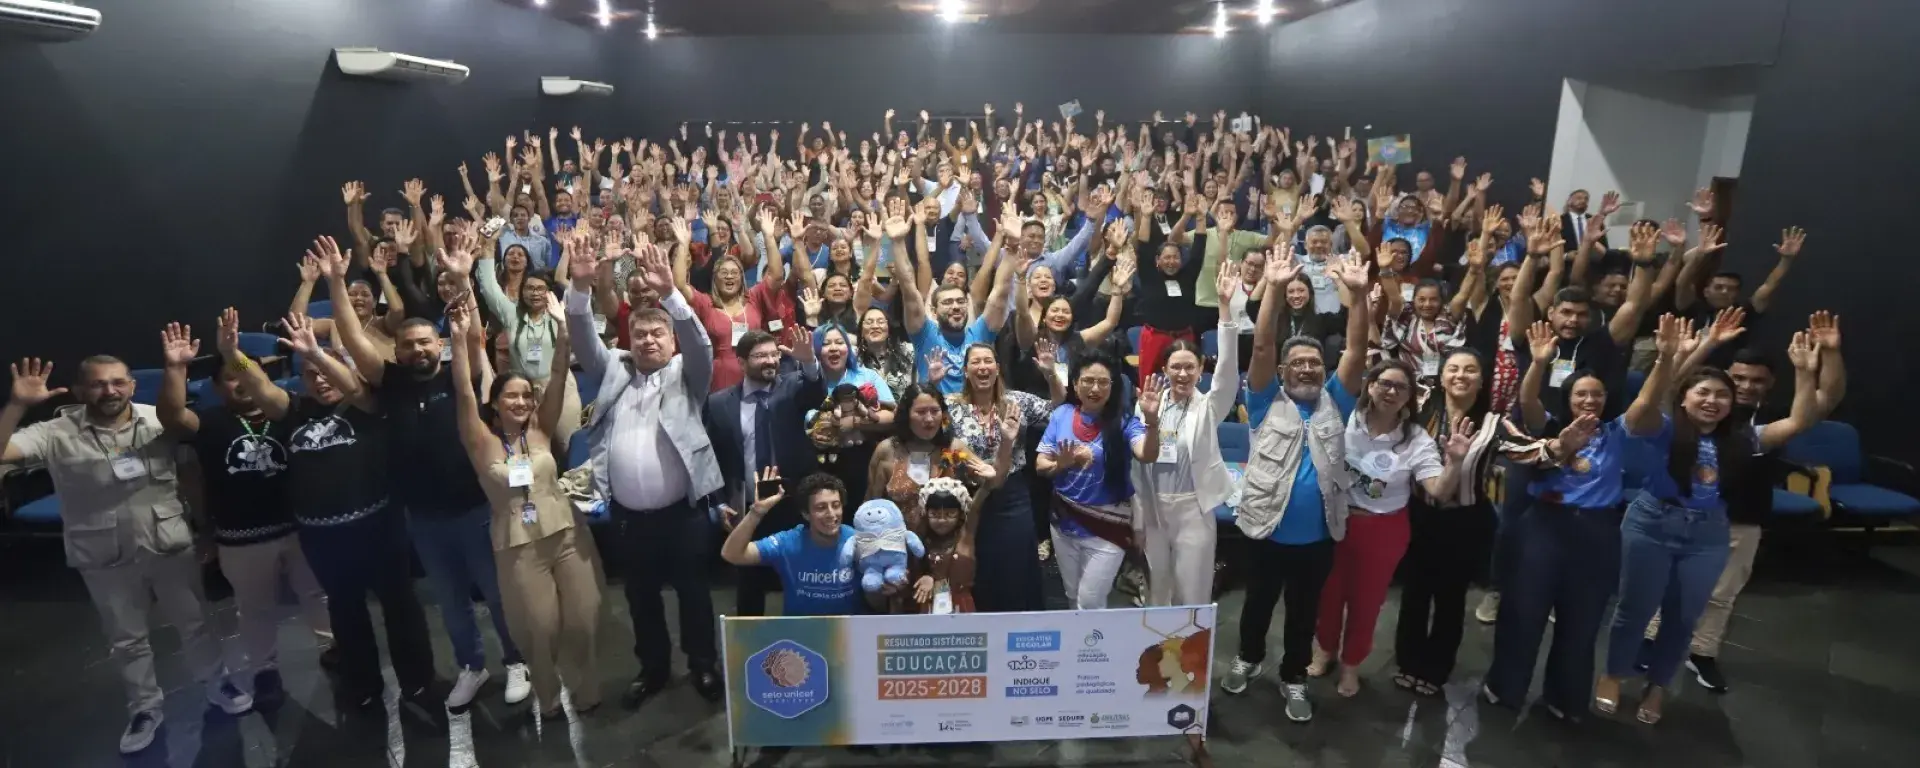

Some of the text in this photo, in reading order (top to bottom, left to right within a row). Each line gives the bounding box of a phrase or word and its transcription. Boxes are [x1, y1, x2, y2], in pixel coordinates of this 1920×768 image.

[798, 568, 838, 584] unicef
[884, 636, 983, 647] RESULTADO SISTÊMICO 2
[885, 652, 980, 673] EDUCAÇÃO
[1014, 677, 1050, 685] INDIQUE
[884, 679, 981, 696] 2025-2028
[1030, 686, 1050, 694] SELO
[784, 690, 814, 698] unicef
